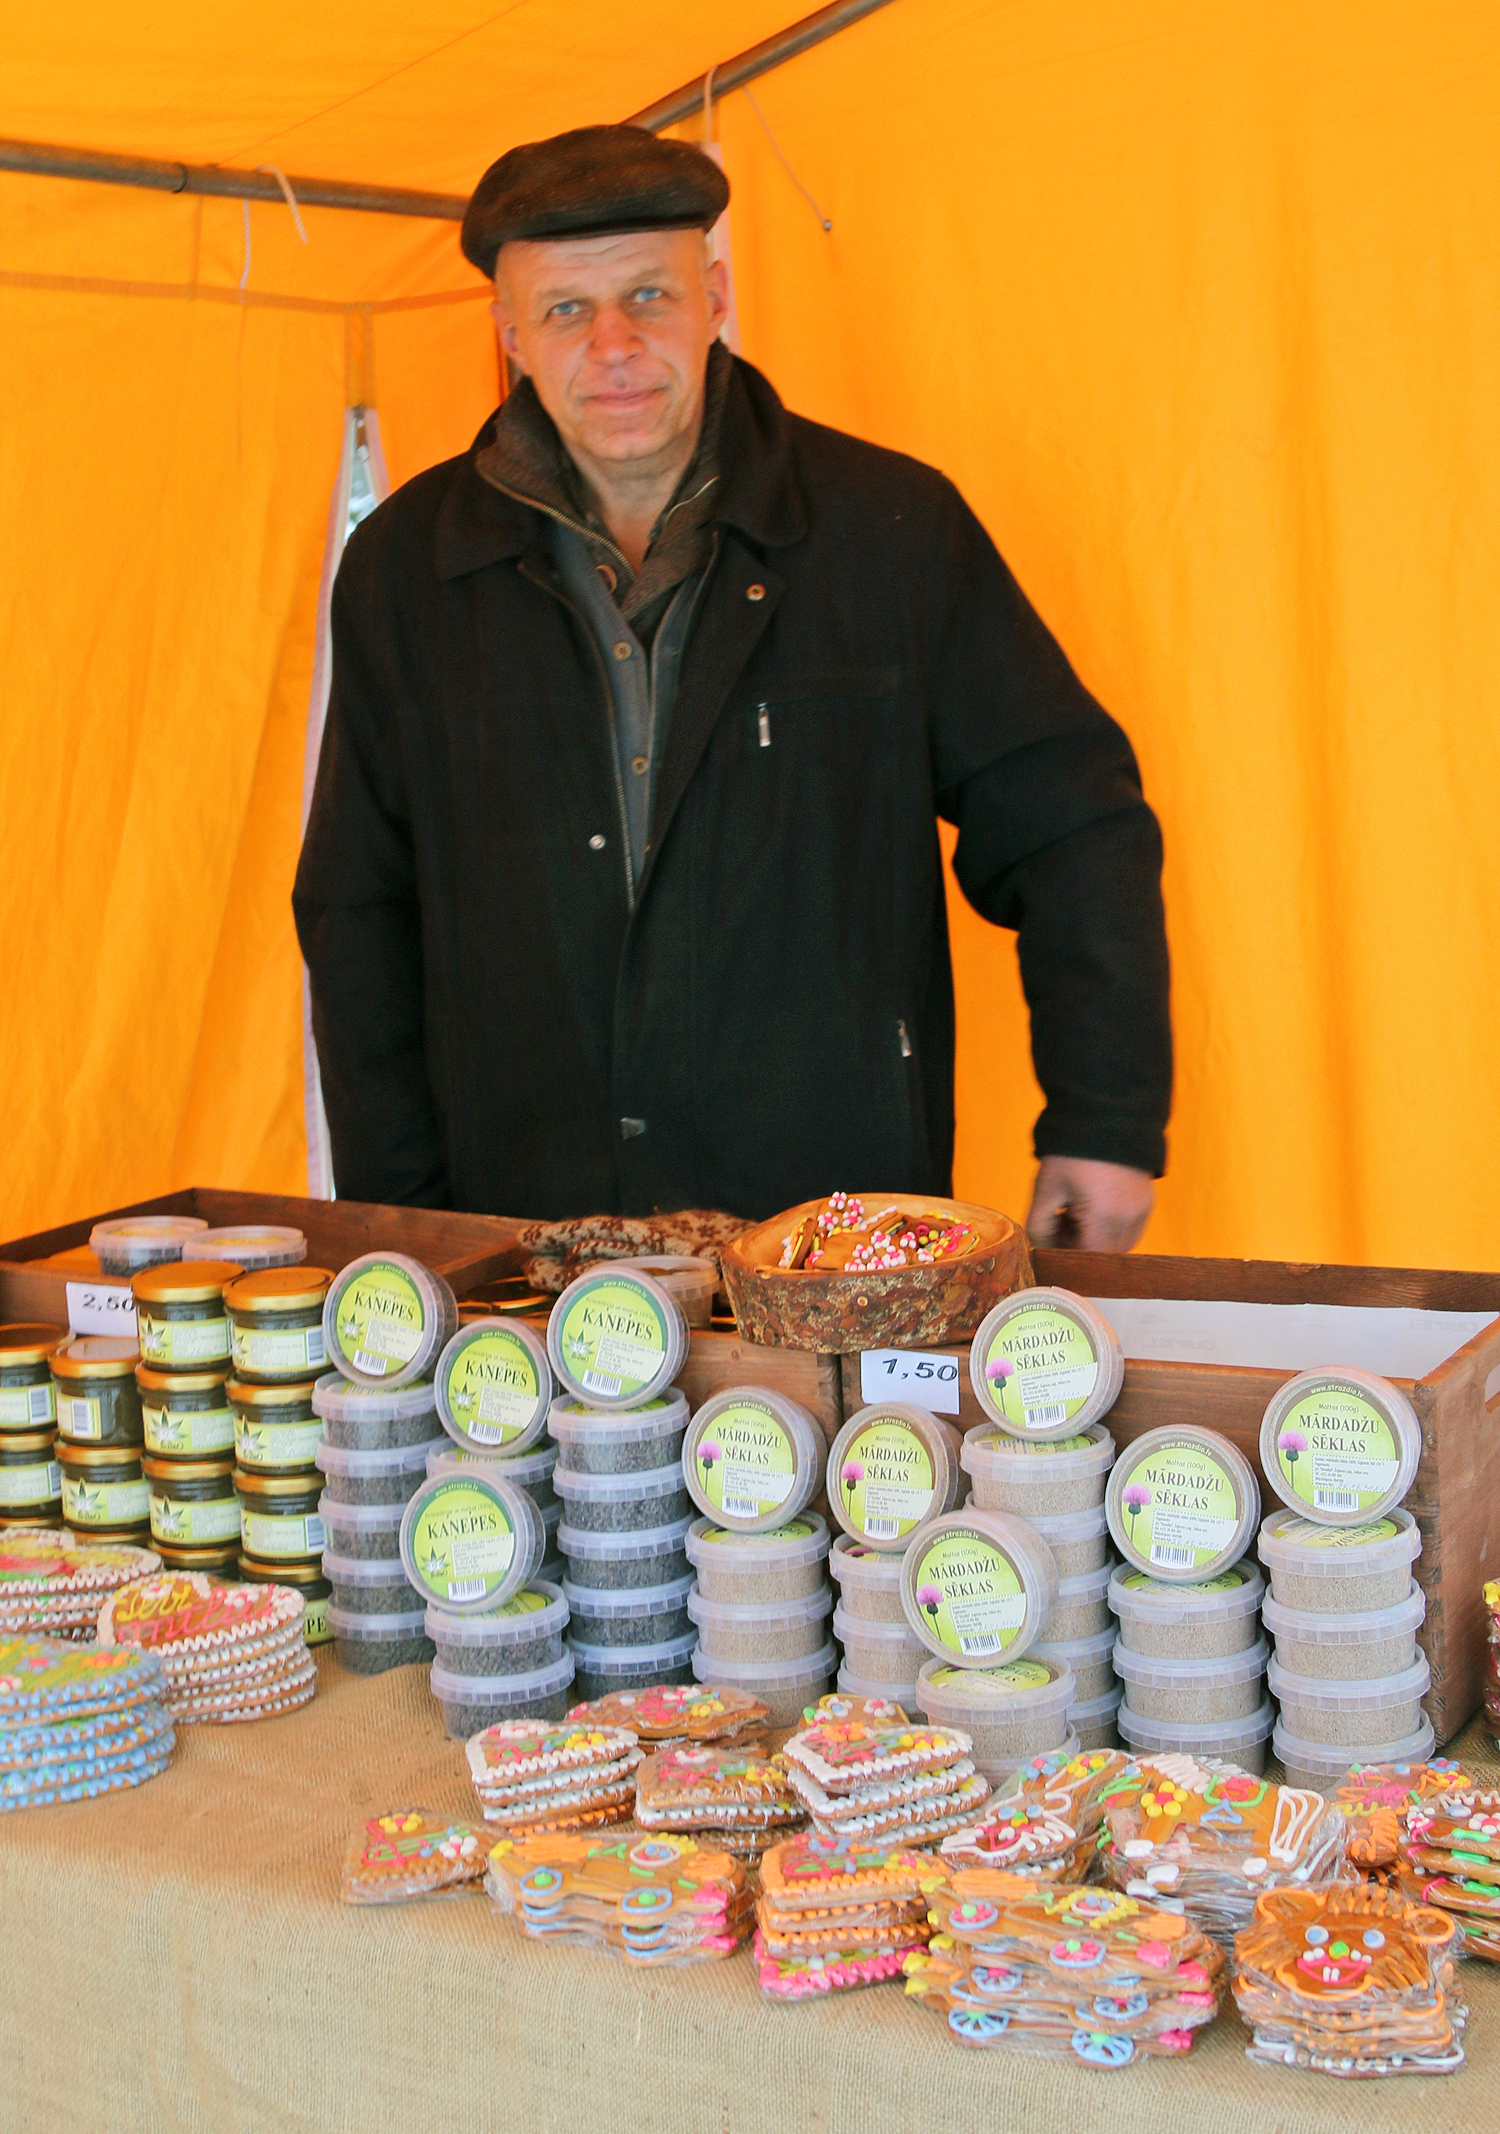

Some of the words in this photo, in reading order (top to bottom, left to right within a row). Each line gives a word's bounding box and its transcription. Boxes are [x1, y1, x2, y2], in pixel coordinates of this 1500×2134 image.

[82, 1292, 136, 1312] 2,50
[1002, 1326, 1076, 1355] MĀRDADŽU
[881, 1358, 958, 1382] 1,50
[1016, 1349, 1066, 1371] SĒKLAS
[1318, 1403, 1339, 1411] Maltas
[1339, 1403, 1360, 1413] (100g)
[1298, 1413, 1380, 1434] MĀRDADŽU
[715, 1426, 783, 1449] MĀRDADŽU
[1312, 1434, 1366, 1454] SĒKLAS
[724, 1446, 770, 1466] SĒKLAS
[859, 1444, 923, 1465] MĀRDADŽU
[866, 1463, 909, 1482] SĒKLAS
[1186, 1461, 1206, 1471] (100g)
[1144, 1467, 1225, 1493] MĀRDADŽU
[1155, 1489, 1209, 1511] SĒKLAS
[929, 1555, 1001, 1581] MĀRDADŽU
[944, 1578, 994, 1599] SĒKLAS
